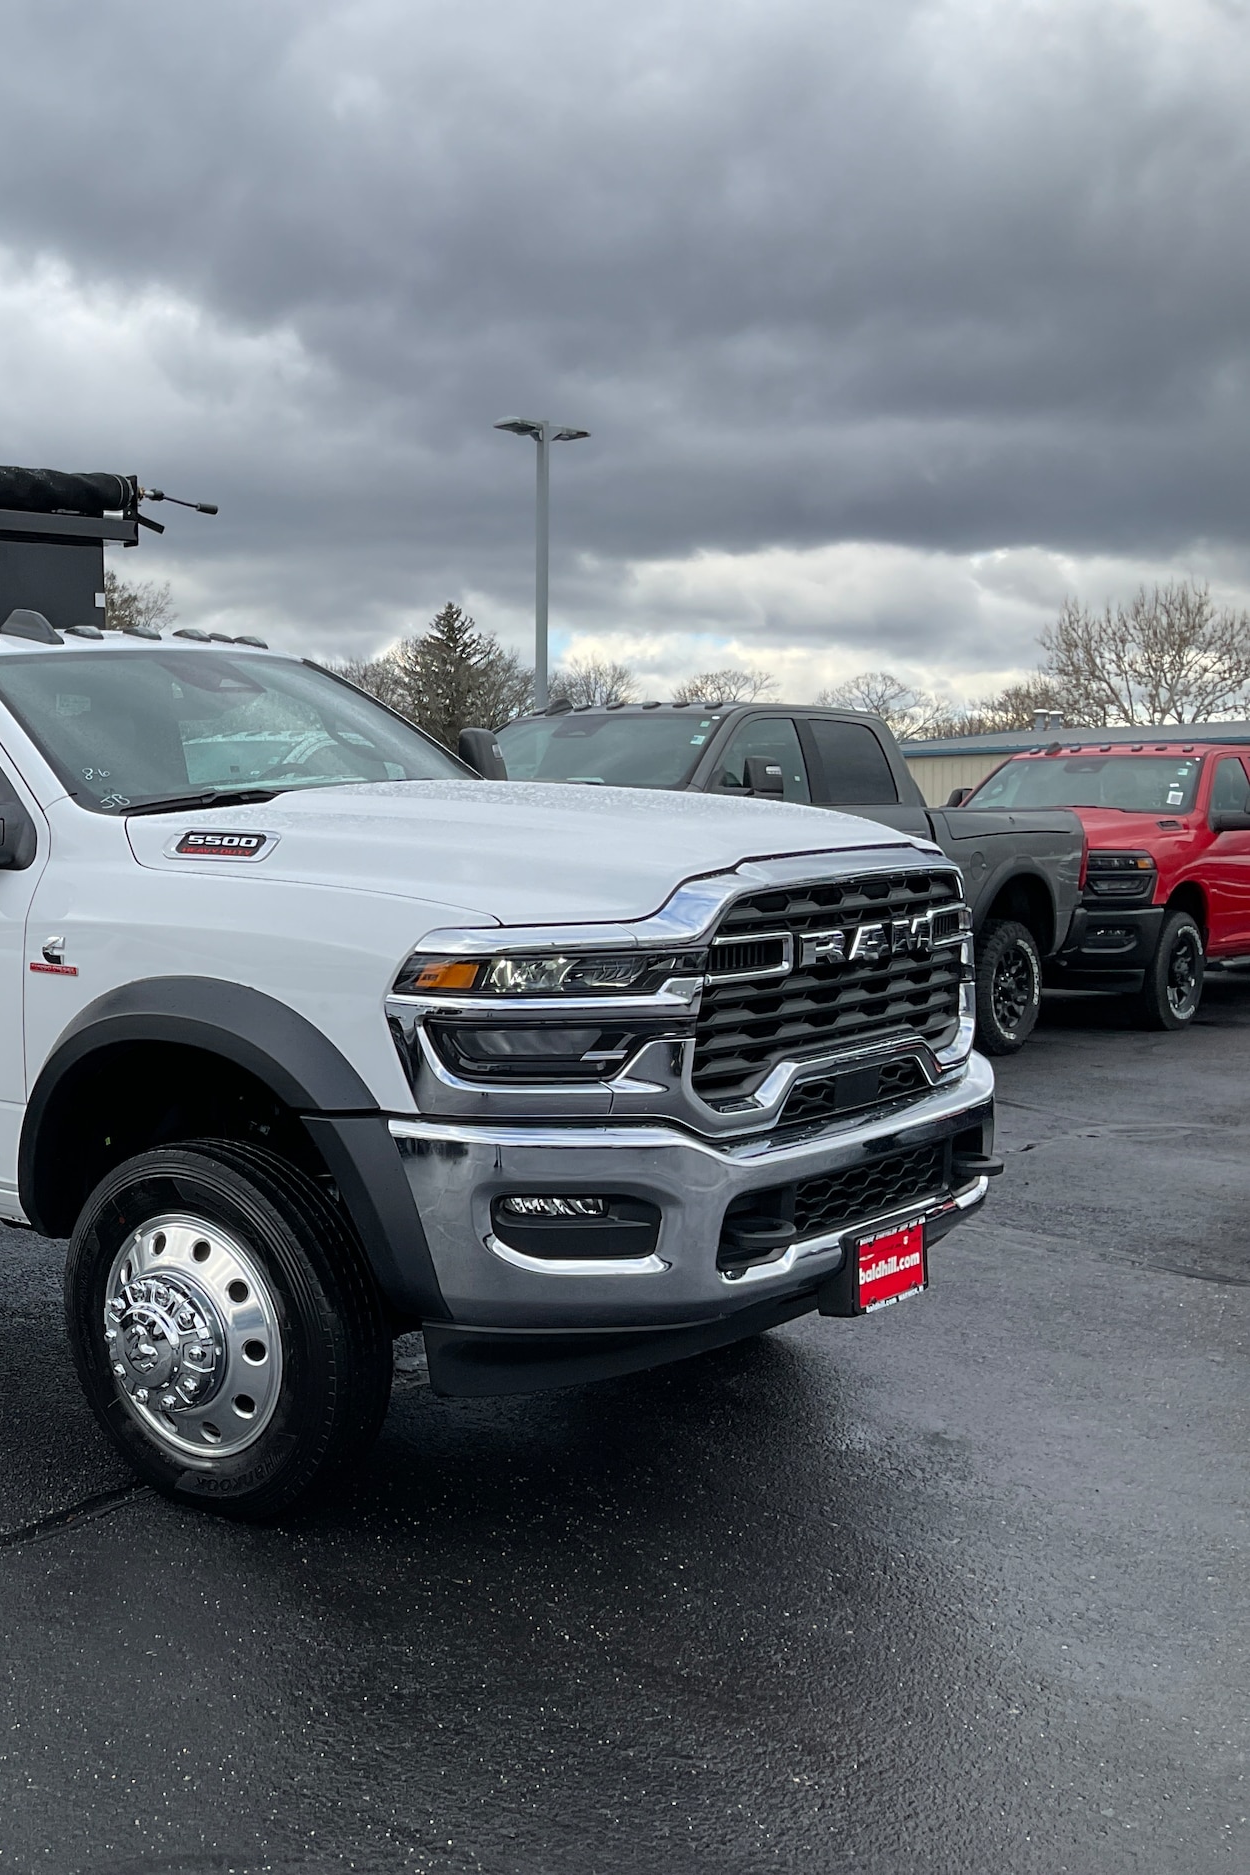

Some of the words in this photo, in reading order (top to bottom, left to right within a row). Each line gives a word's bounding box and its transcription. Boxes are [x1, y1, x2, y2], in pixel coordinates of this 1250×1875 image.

[181, 846, 218, 856] HEAVY
[219, 847, 254, 857] DUTY
[187, 834, 259, 848] 5500
[800, 917, 931, 969] RAM
[859, 1251, 921, 1286] baldhill.com
